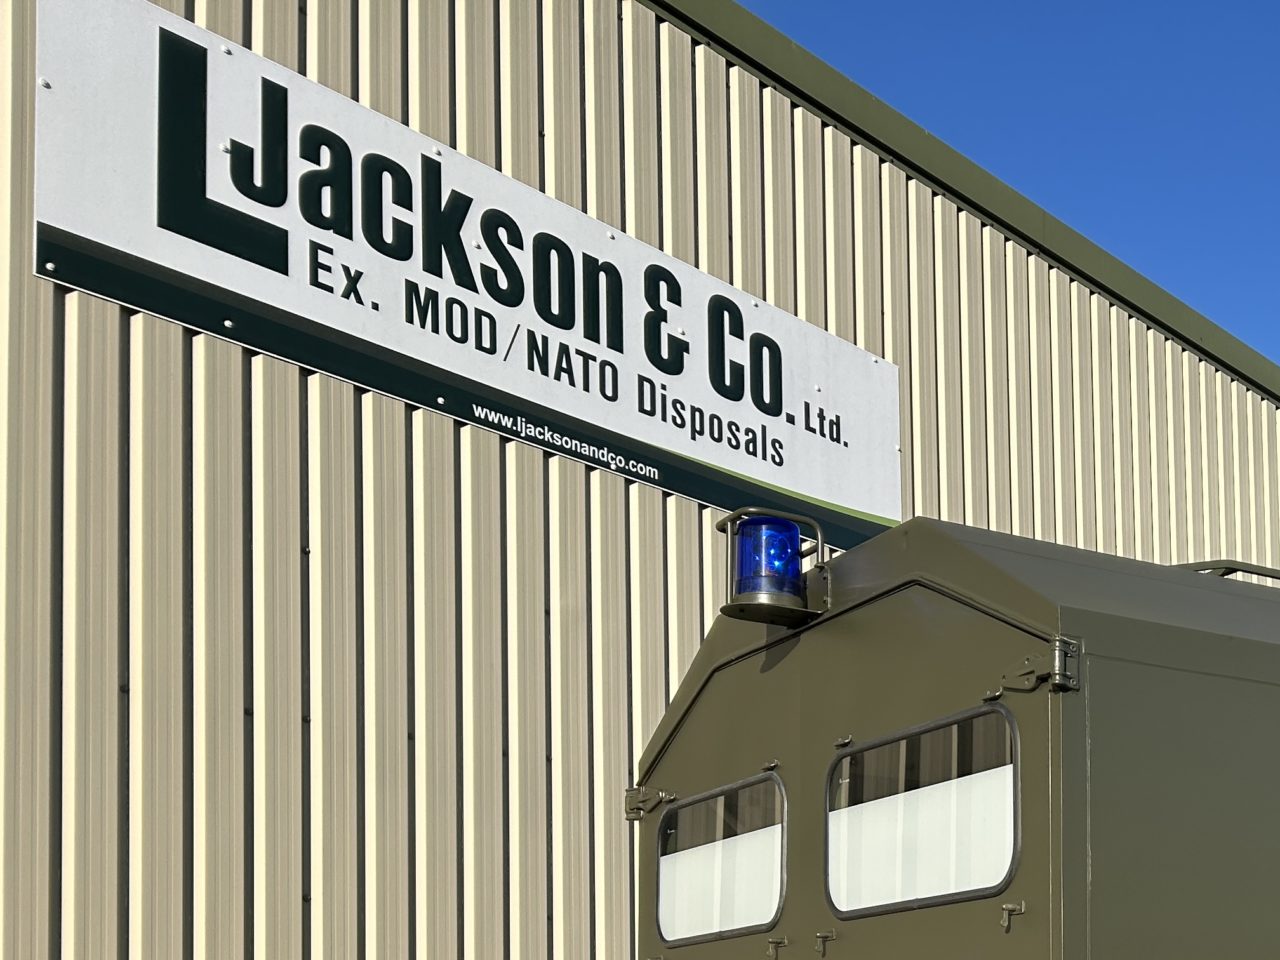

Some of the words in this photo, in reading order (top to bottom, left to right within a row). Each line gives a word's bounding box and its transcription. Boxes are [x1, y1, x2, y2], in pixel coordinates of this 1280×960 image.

[308, 239, 379, 312] Ex.
[637, 374, 784, 467] Disposals
[472, 403, 659, 480] www.ljacksonandco.com
[644, 264, 689, 375] &
[708, 294, 795, 426] Co.
[804, 401, 849, 448] Ltd.
